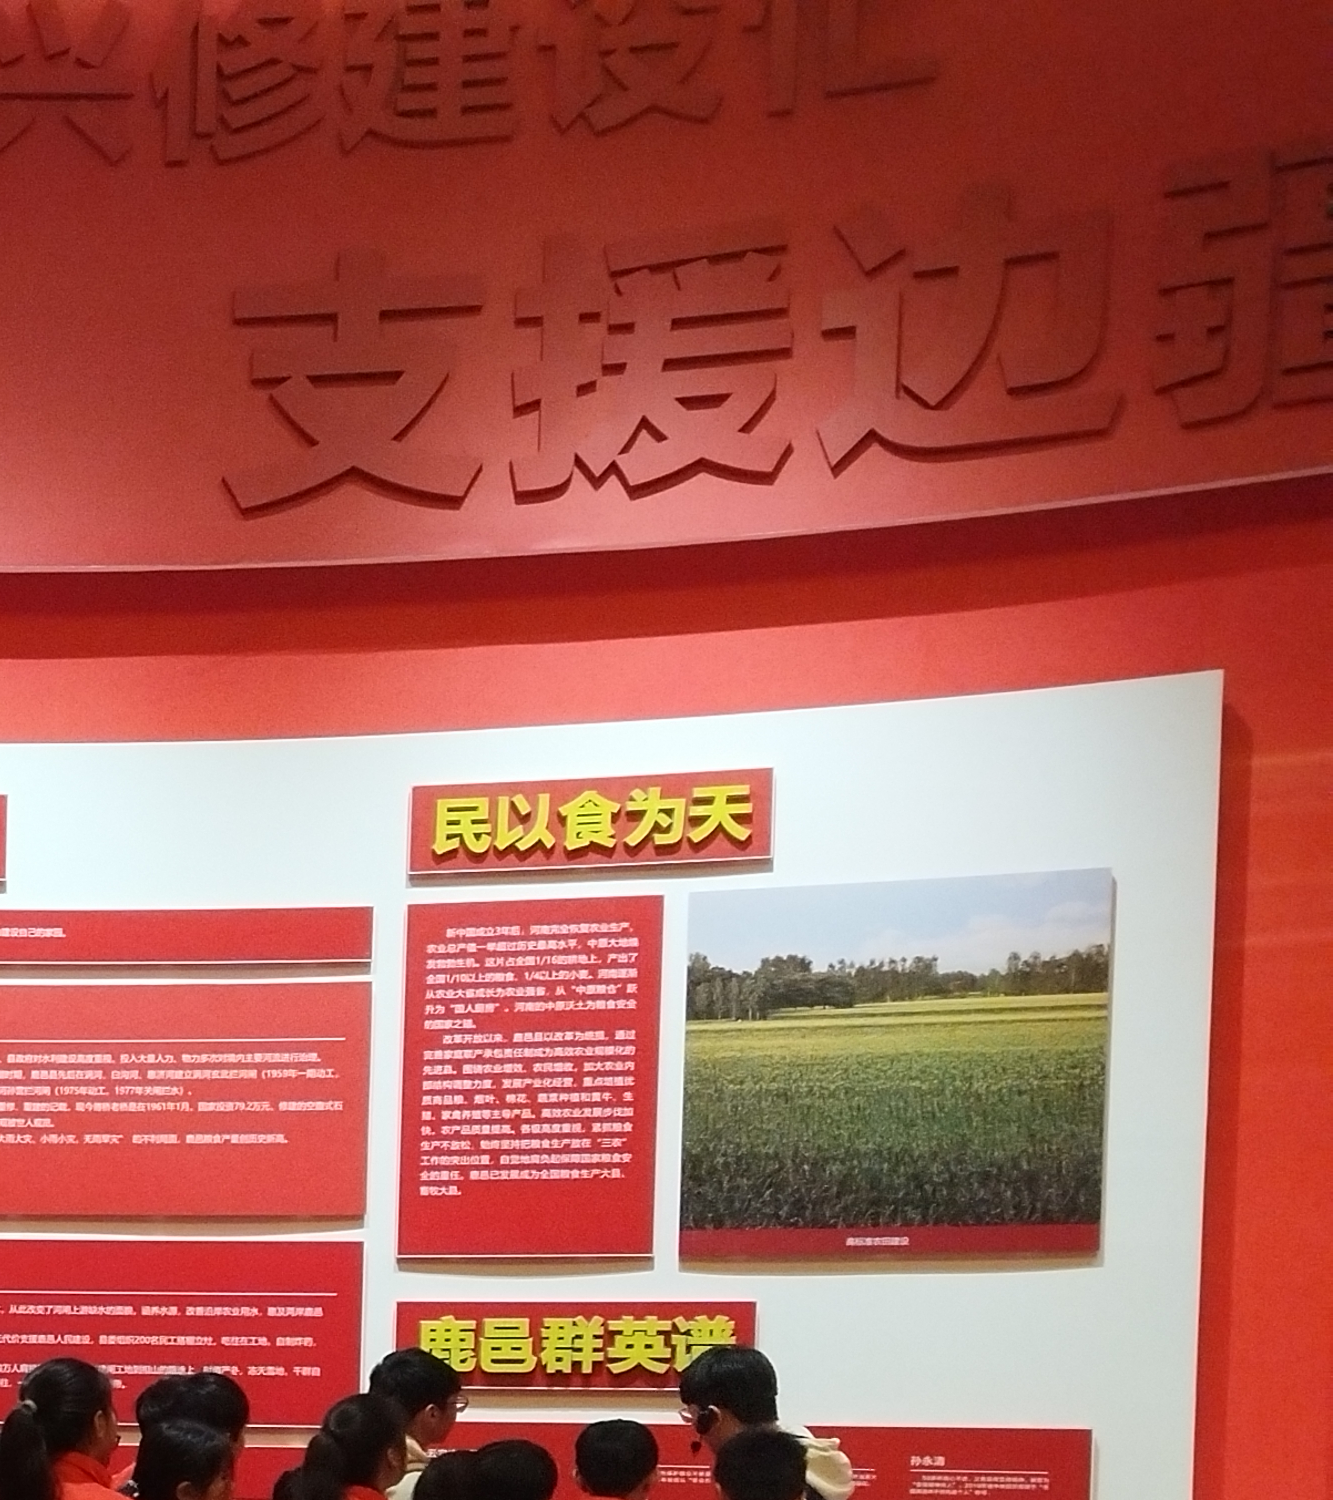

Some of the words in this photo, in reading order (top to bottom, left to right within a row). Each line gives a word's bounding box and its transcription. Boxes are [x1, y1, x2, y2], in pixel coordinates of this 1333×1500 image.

[431, 783, 754, 858] 民以食为天
[419, 1315, 737, 1375] 鹿邑群英谱
